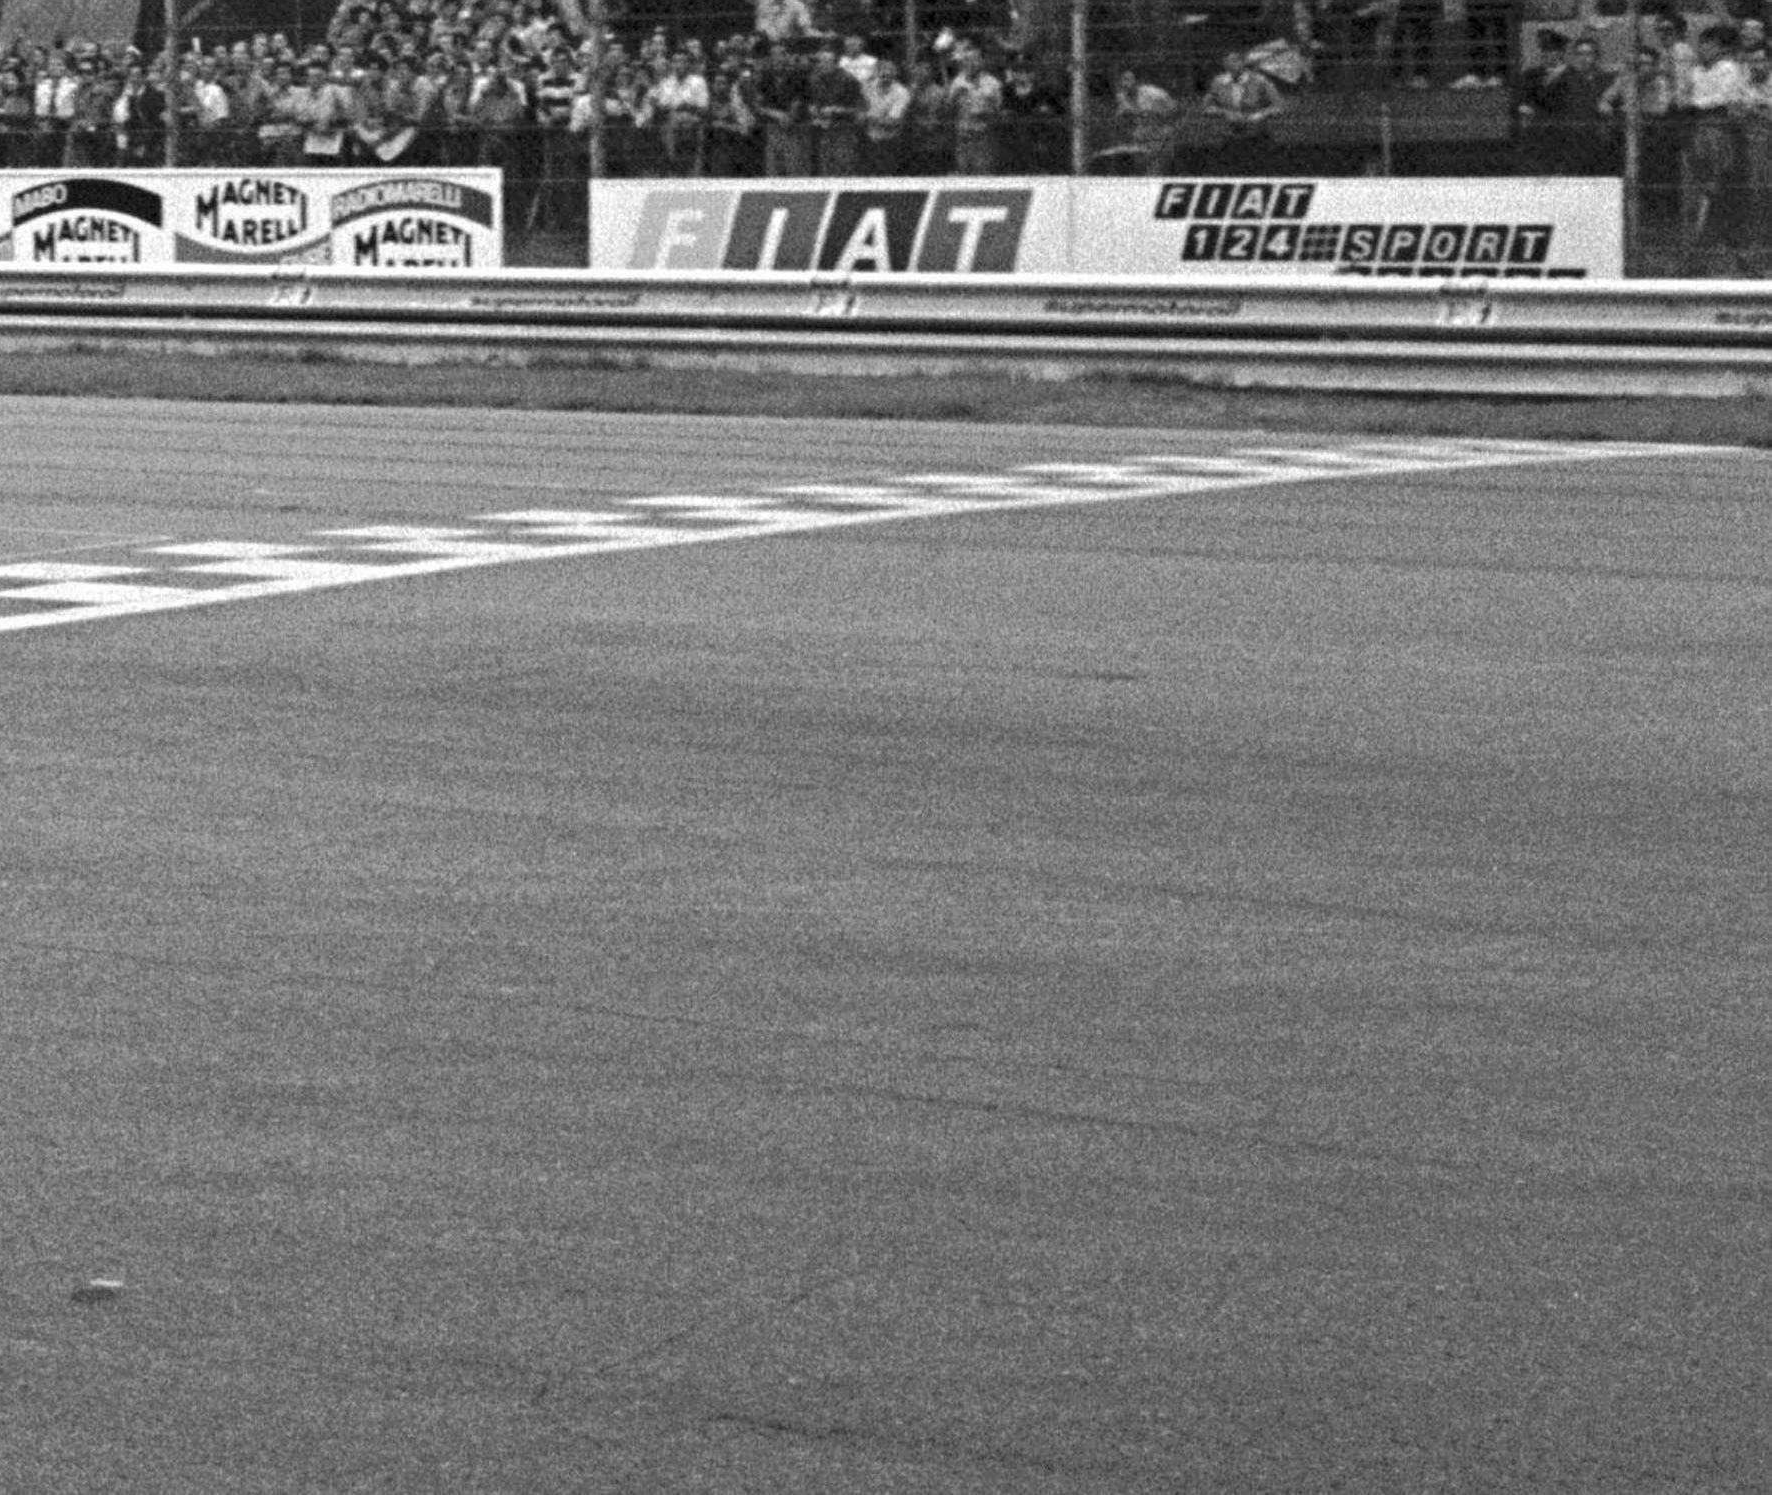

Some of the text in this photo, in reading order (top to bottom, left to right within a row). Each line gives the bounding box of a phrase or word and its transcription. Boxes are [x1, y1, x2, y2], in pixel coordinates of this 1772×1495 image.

[196, 179, 307, 215] MAGNETI
[1158, 184, 1312, 218] FIAT
[34, 216, 140, 251] MAGNETI
[355, 218, 471, 255] MAGNETI
[652, 203, 1013, 272] FIAT
[1342, 226, 1550, 262] SPORT
